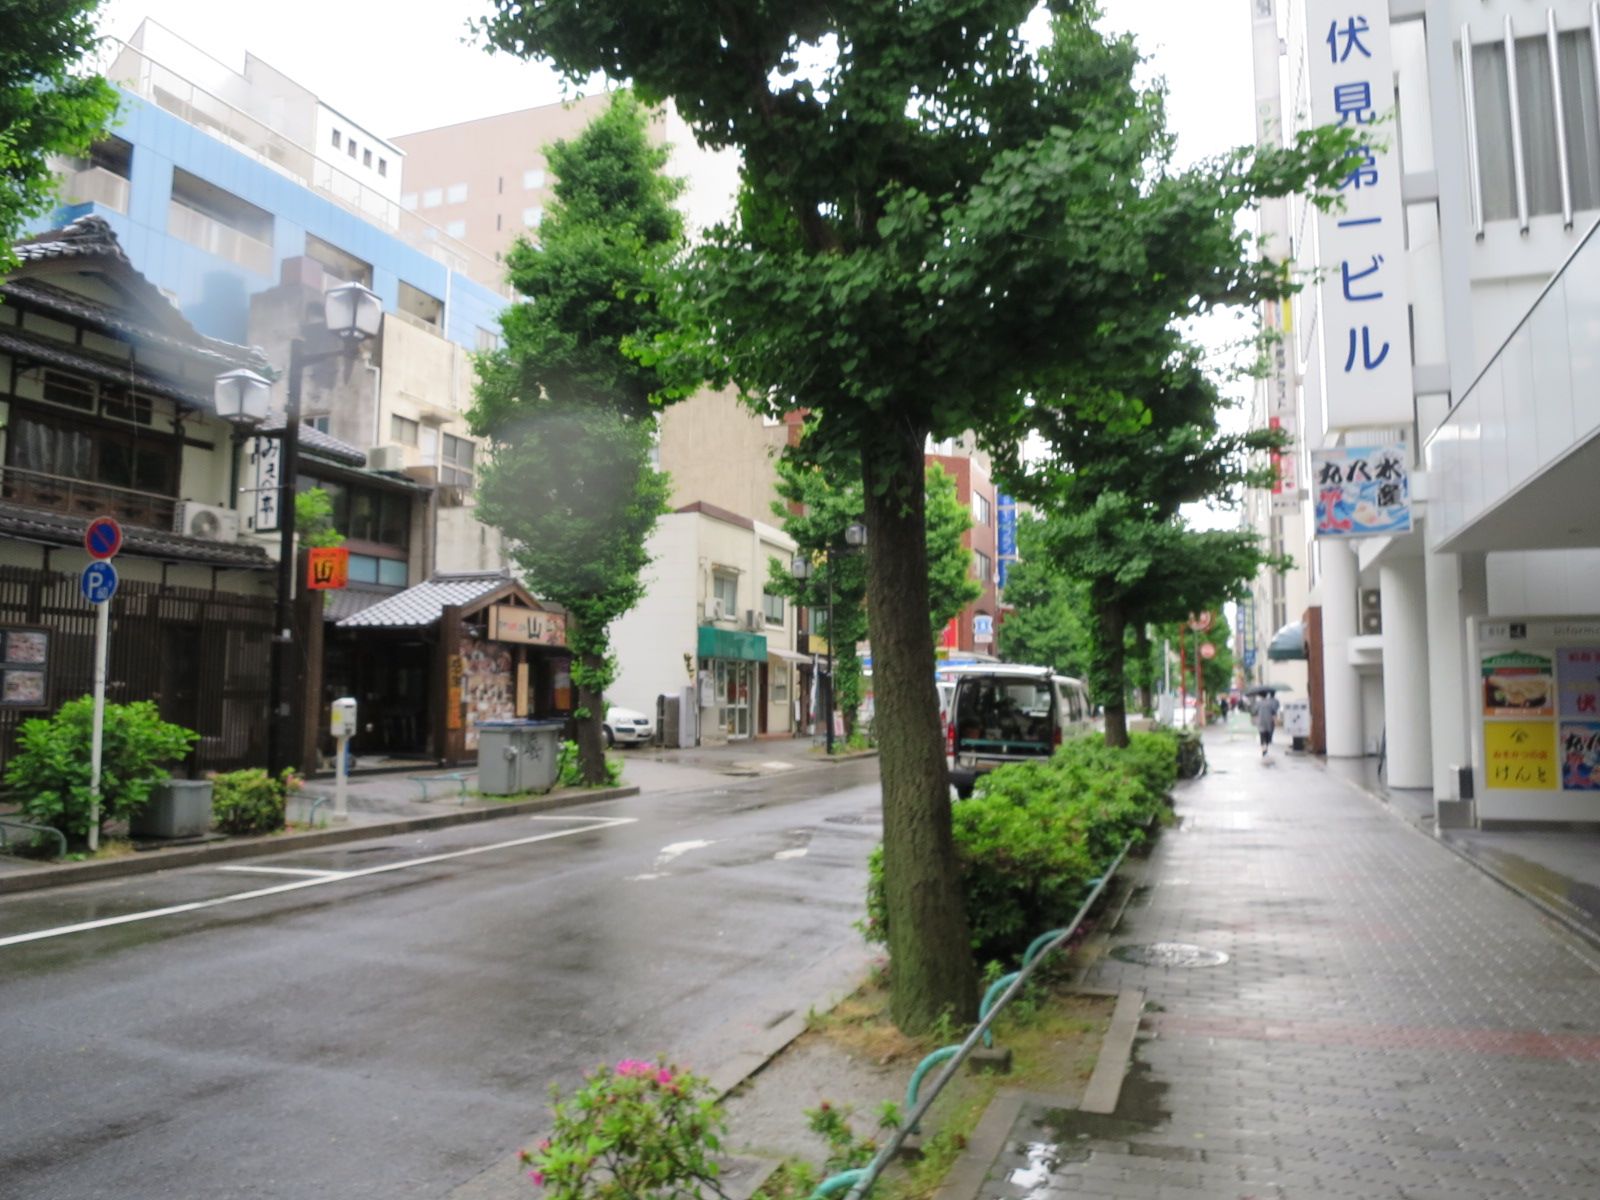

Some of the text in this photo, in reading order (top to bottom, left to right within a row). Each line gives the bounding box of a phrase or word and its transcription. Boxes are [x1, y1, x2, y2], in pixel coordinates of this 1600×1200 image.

[1326, 16, 1390, 373] 伏見第一ビル
[314, 559, 335, 584] 山
[88, 572, 103, 599] P
[527, 616, 542, 639] 山
